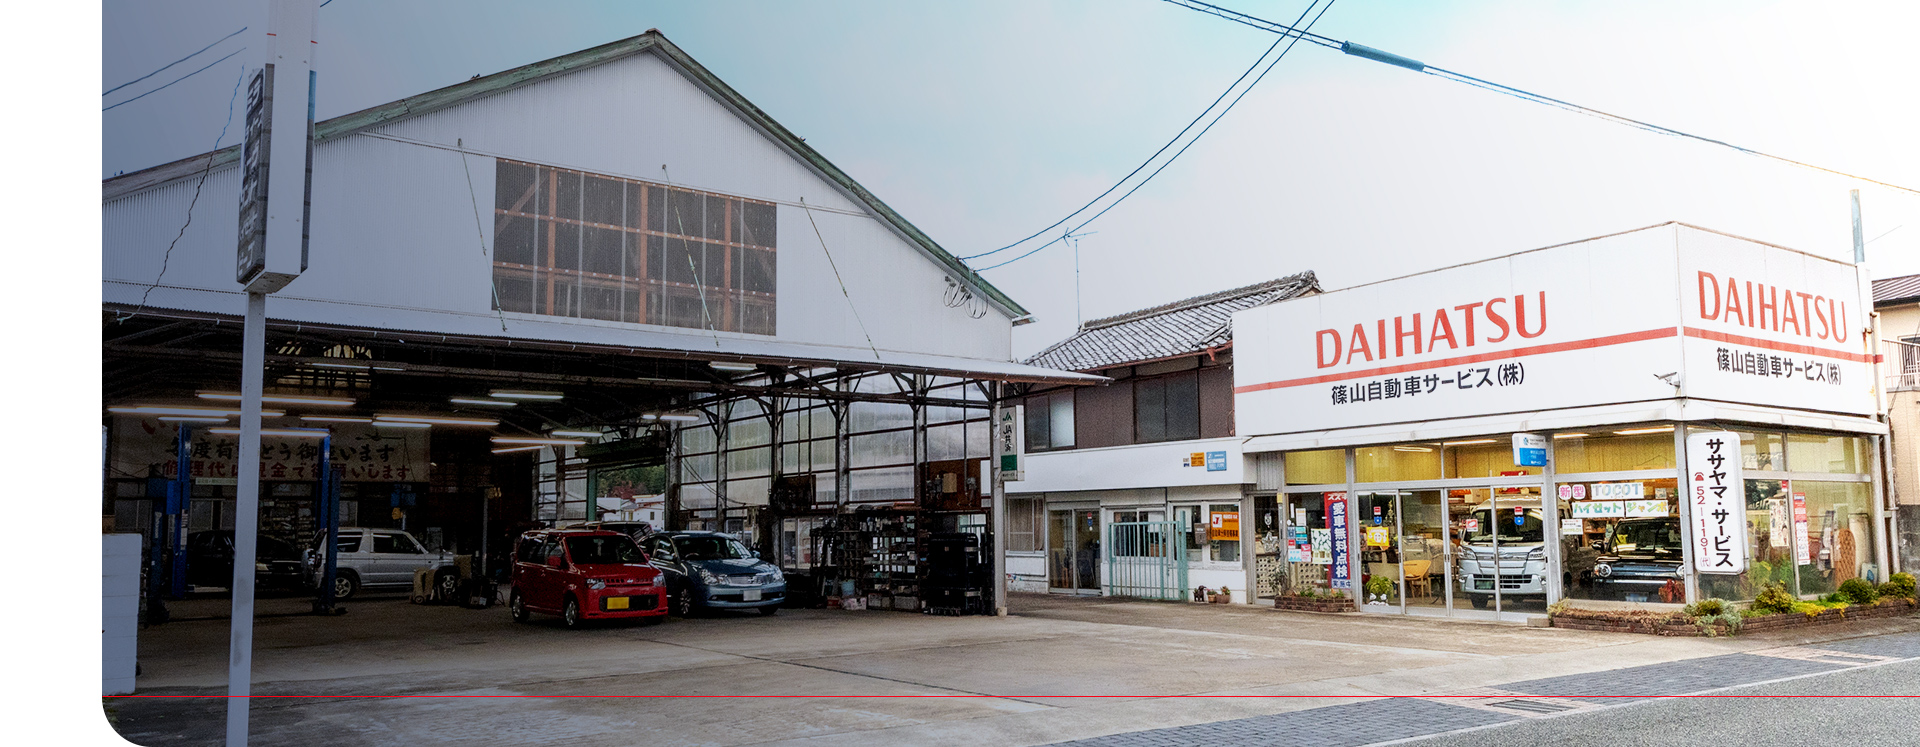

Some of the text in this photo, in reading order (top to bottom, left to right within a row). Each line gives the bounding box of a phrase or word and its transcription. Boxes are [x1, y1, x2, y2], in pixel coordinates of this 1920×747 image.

[1697, 270, 1848, 344] DAIHATSU
[1315, 290, 1547, 369] DAIHATSU
[1331, 362, 1525, 405] 篠山自動車サービス(株)
[1717, 347, 1842, 385] 篠山自動車サービス(株)
[1560, 485, 1585, 498] 新型
[1573, 501, 1668, 514] ハイゼット ジャンボ
[1593, 484, 1639, 496] TOCOT
[1706, 438, 1734, 567] ササヤマ・サービス
[1332, 501, 1348, 577] 愛車無料点検
